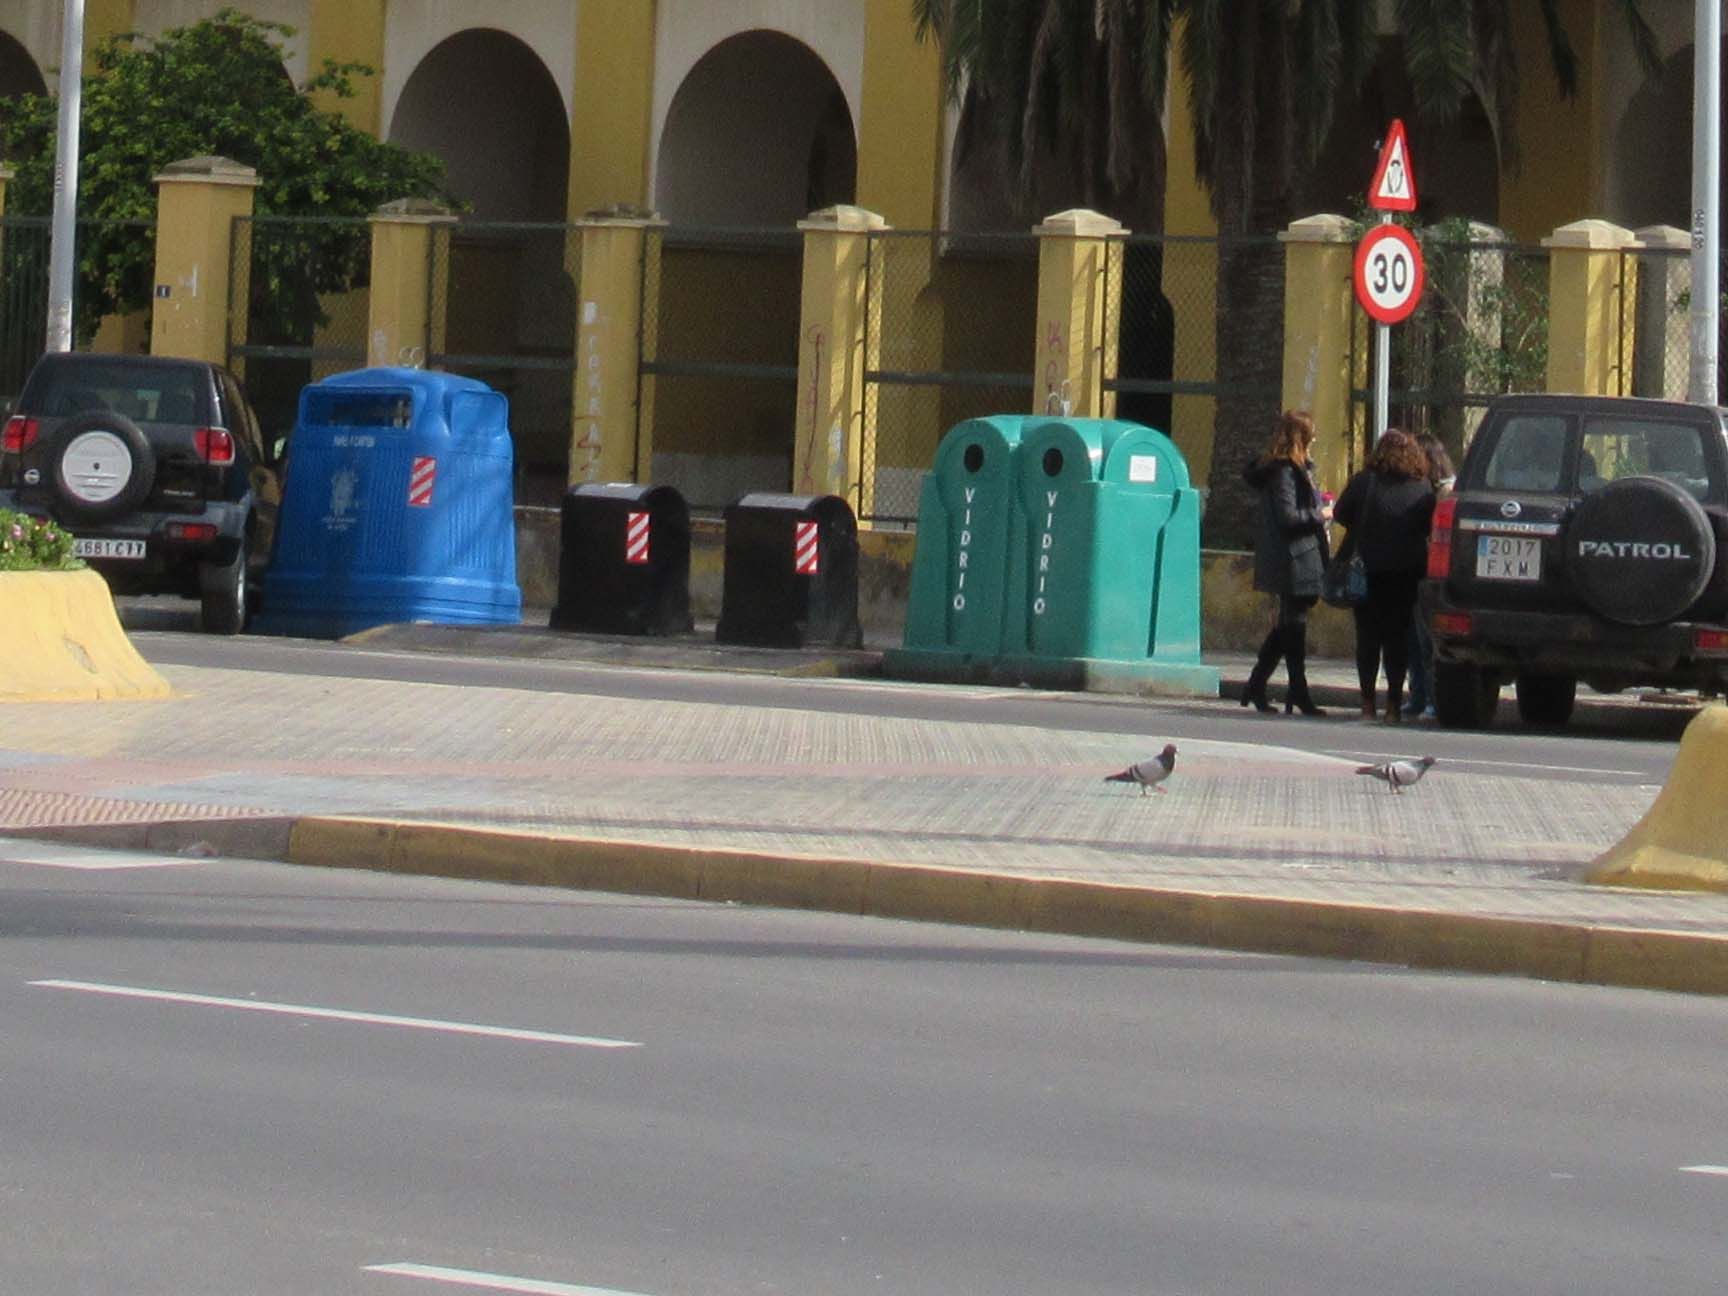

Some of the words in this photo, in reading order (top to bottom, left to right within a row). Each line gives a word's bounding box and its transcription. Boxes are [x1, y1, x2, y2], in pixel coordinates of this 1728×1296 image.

[1373, 253, 1407, 294] 30
[953, 487, 975, 610] VIDRIO
[1034, 491, 1058, 614] VIDRIO
[1489, 539, 1536, 555] 2017
[1578, 540, 1691, 559] PATROL
